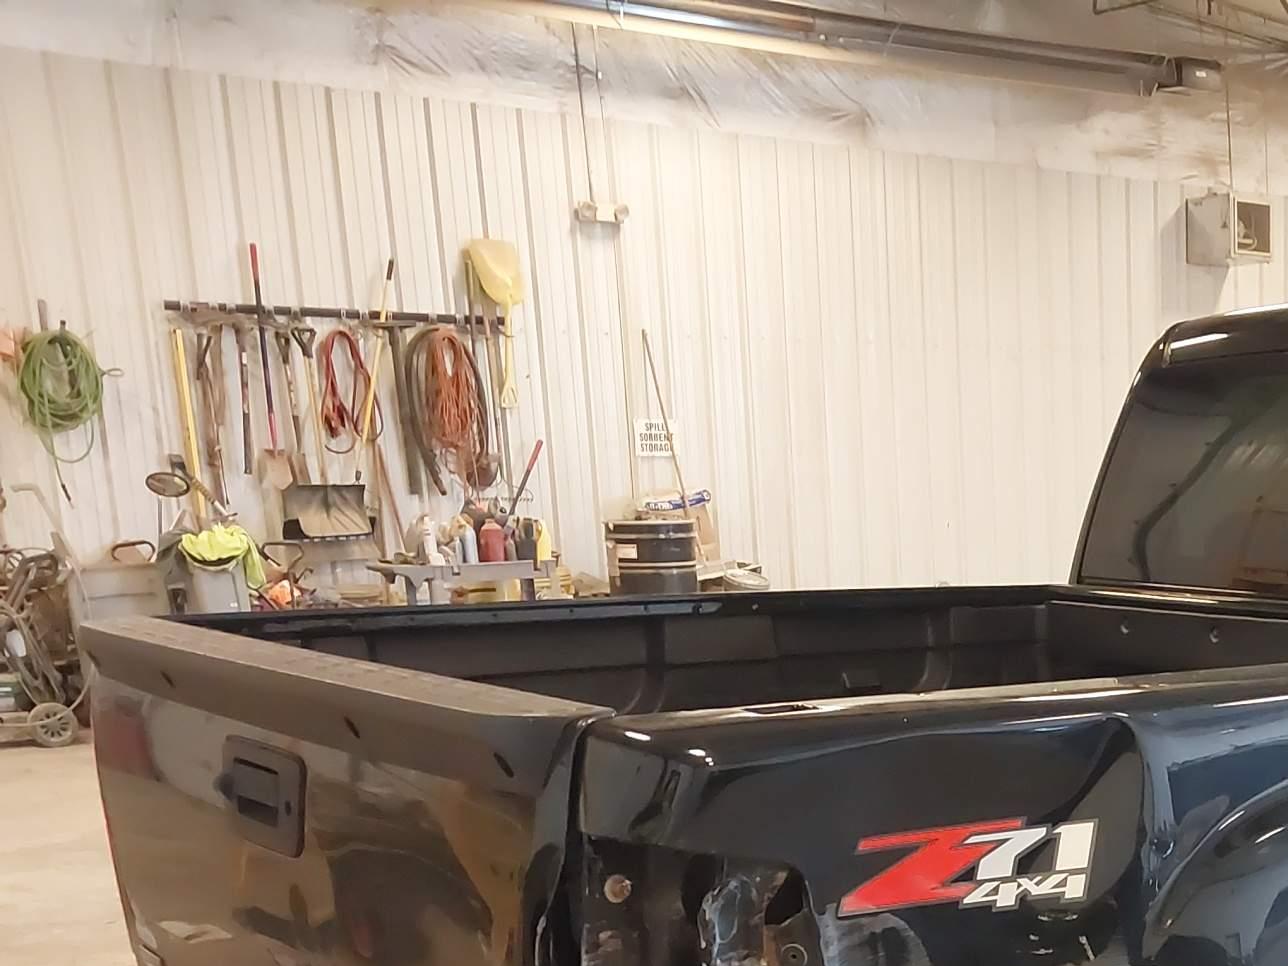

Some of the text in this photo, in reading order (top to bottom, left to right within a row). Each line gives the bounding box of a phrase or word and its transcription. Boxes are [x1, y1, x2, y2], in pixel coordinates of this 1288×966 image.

[644, 422, 667, 432] SPILL
[639, 432, 673, 442] SORBENT
[837, 816, 1099, 917] Z71
